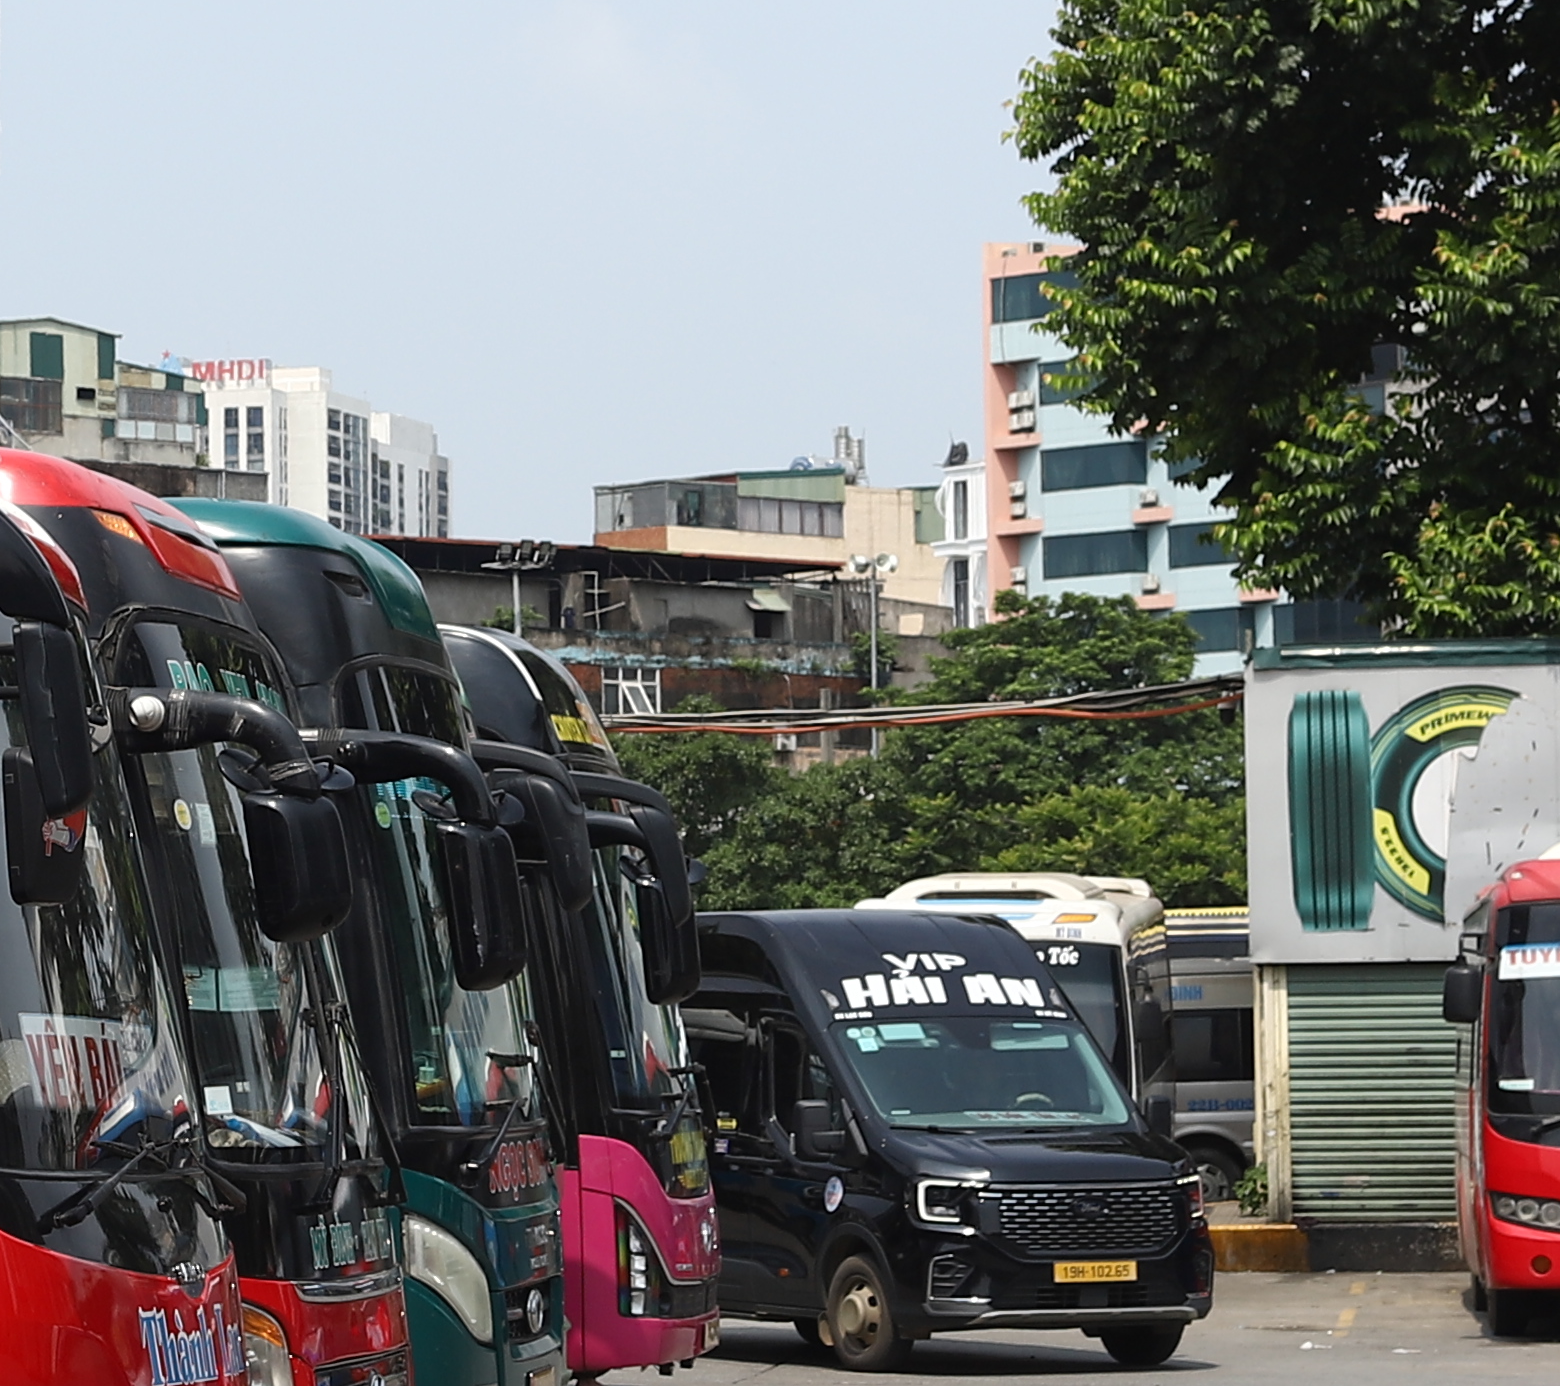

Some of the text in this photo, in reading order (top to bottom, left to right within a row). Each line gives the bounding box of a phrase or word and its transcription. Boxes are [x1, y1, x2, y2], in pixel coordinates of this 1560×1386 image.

[191, 359, 265, 380] MHDI
[882, 952, 967, 971] VIP
[1048, 945, 1080, 966] Tốc
[841, 969, 1045, 1009] HẢI AN
